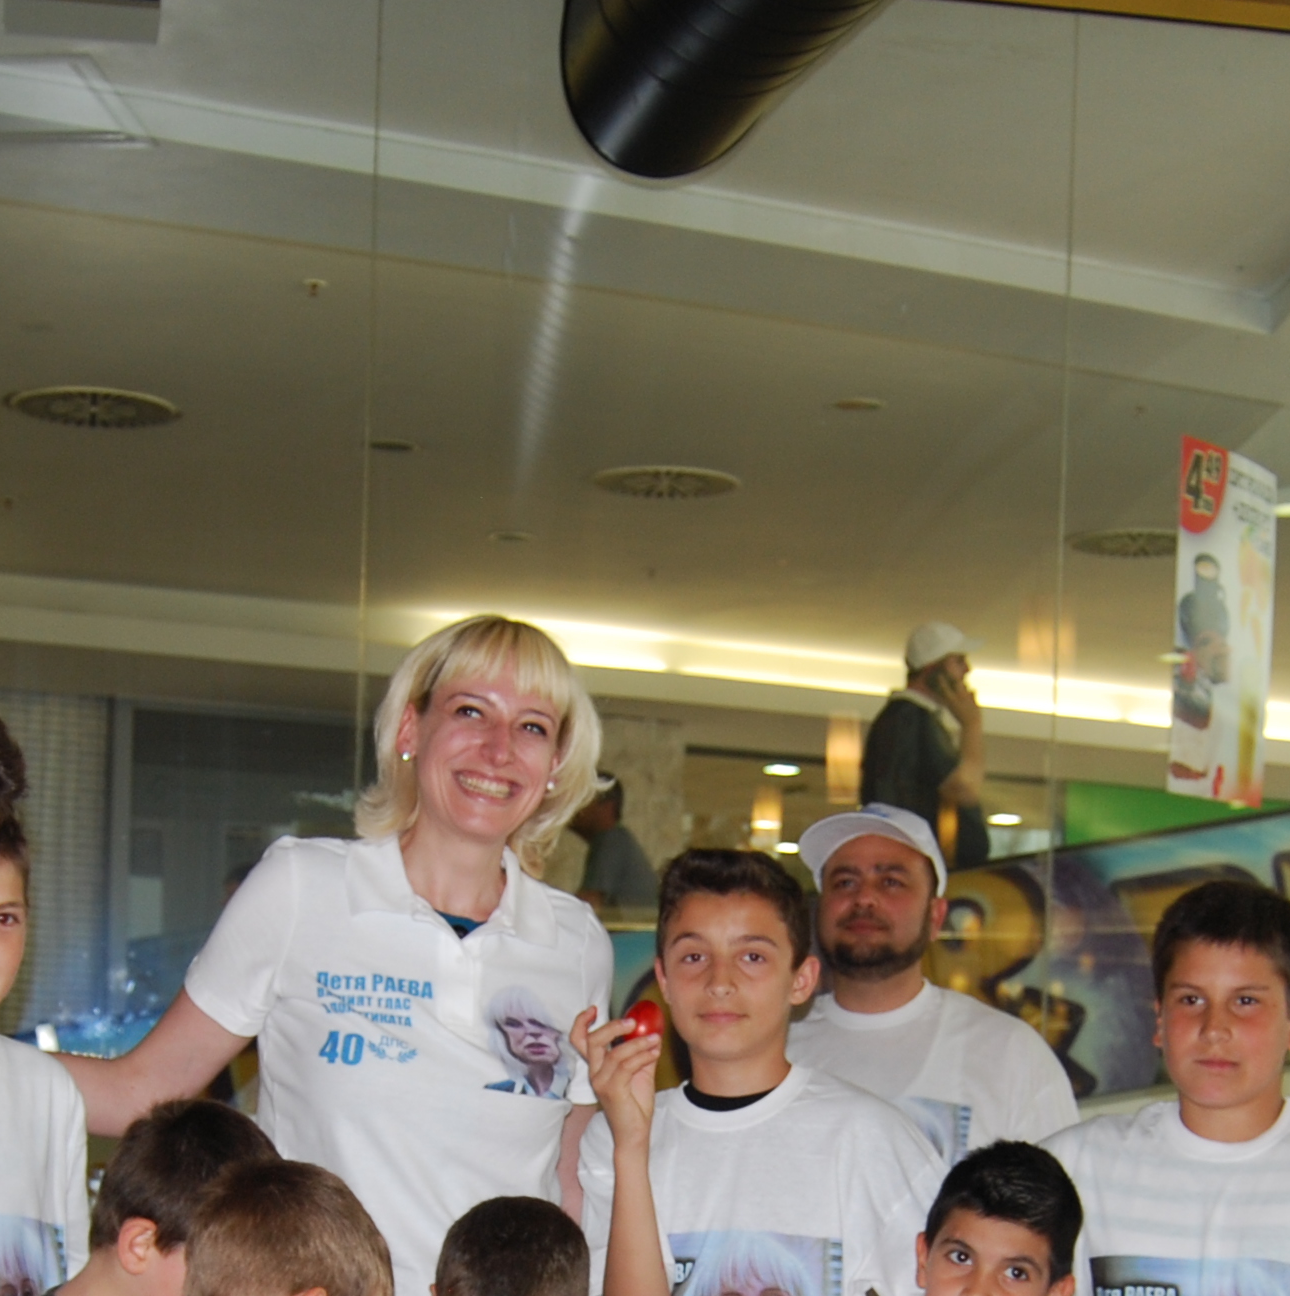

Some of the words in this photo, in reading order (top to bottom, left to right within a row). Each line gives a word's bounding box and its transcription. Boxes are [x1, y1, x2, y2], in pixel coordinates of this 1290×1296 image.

[316, 971, 367, 991] Петя
[372, 973, 433, 999] РАЕВА
[377, 997, 411, 1011] ГЛАС
[318, 1030, 365, 1066] 40
